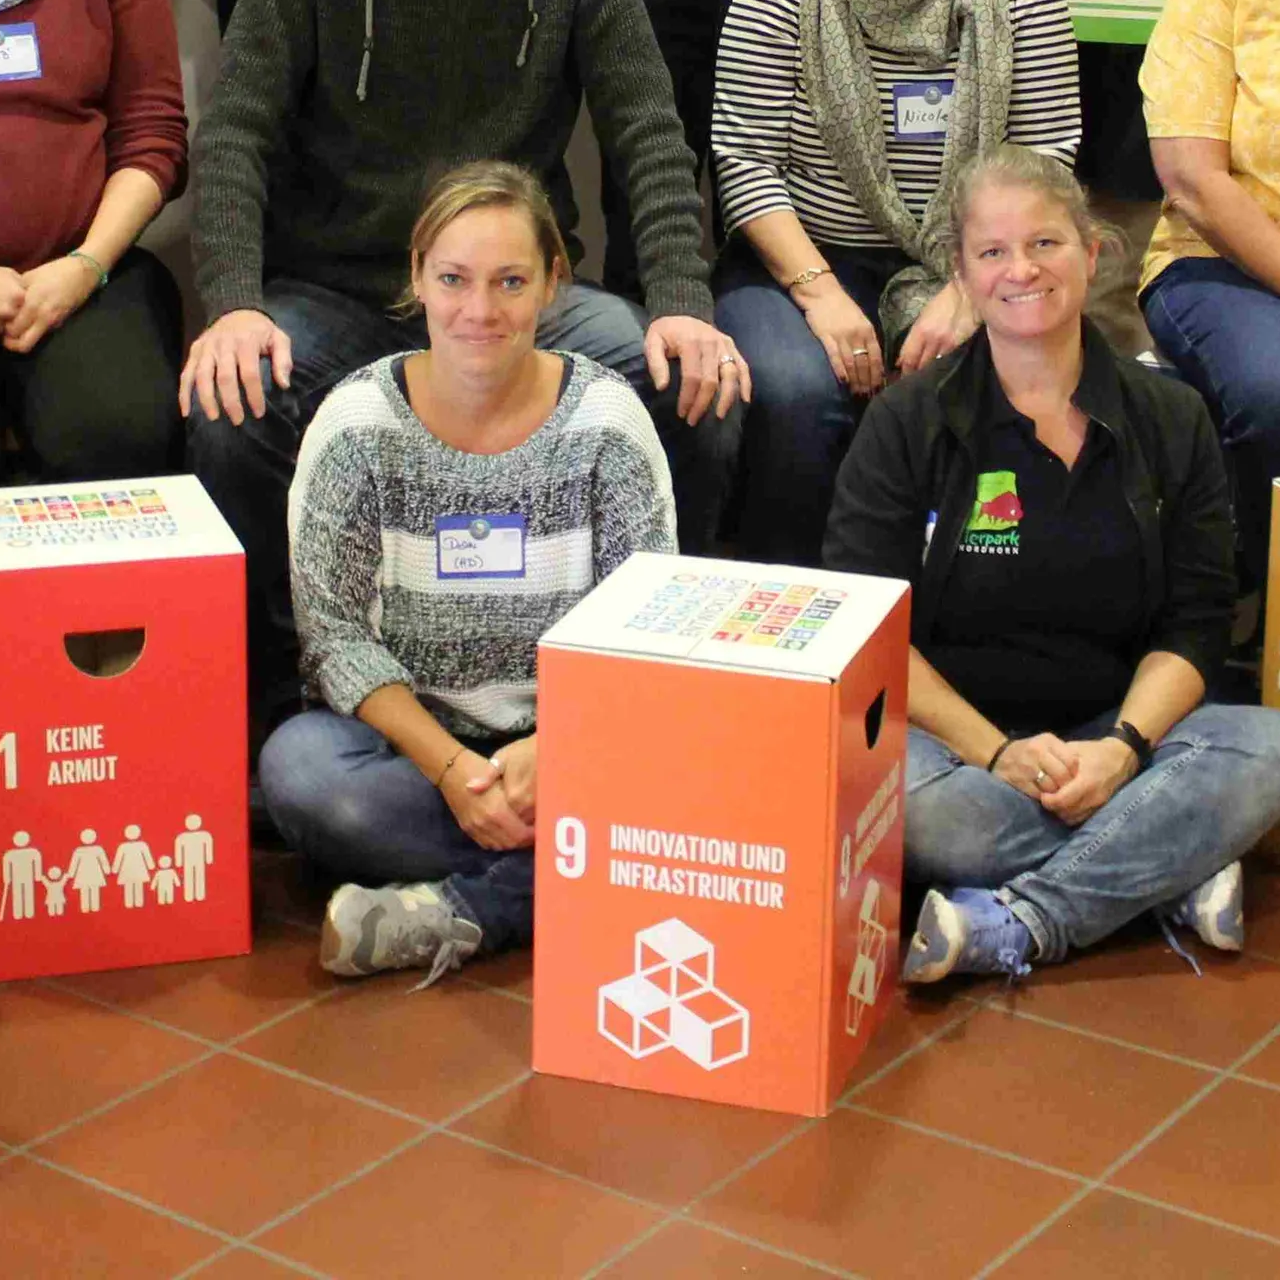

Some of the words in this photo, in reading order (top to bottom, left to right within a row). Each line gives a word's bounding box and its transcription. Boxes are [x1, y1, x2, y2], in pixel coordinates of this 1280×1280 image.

[959, 545, 1019, 555] NORDHORN
[46, 724, 104, 754] KEINE
[48, 755, 118, 786] ARMUT
[554, 816, 586, 879] 9
[610, 824, 735, 869] INNOVATION
[741, 841, 786, 874] UND
[610, 859, 784, 909] INFRASTRUKTUR
